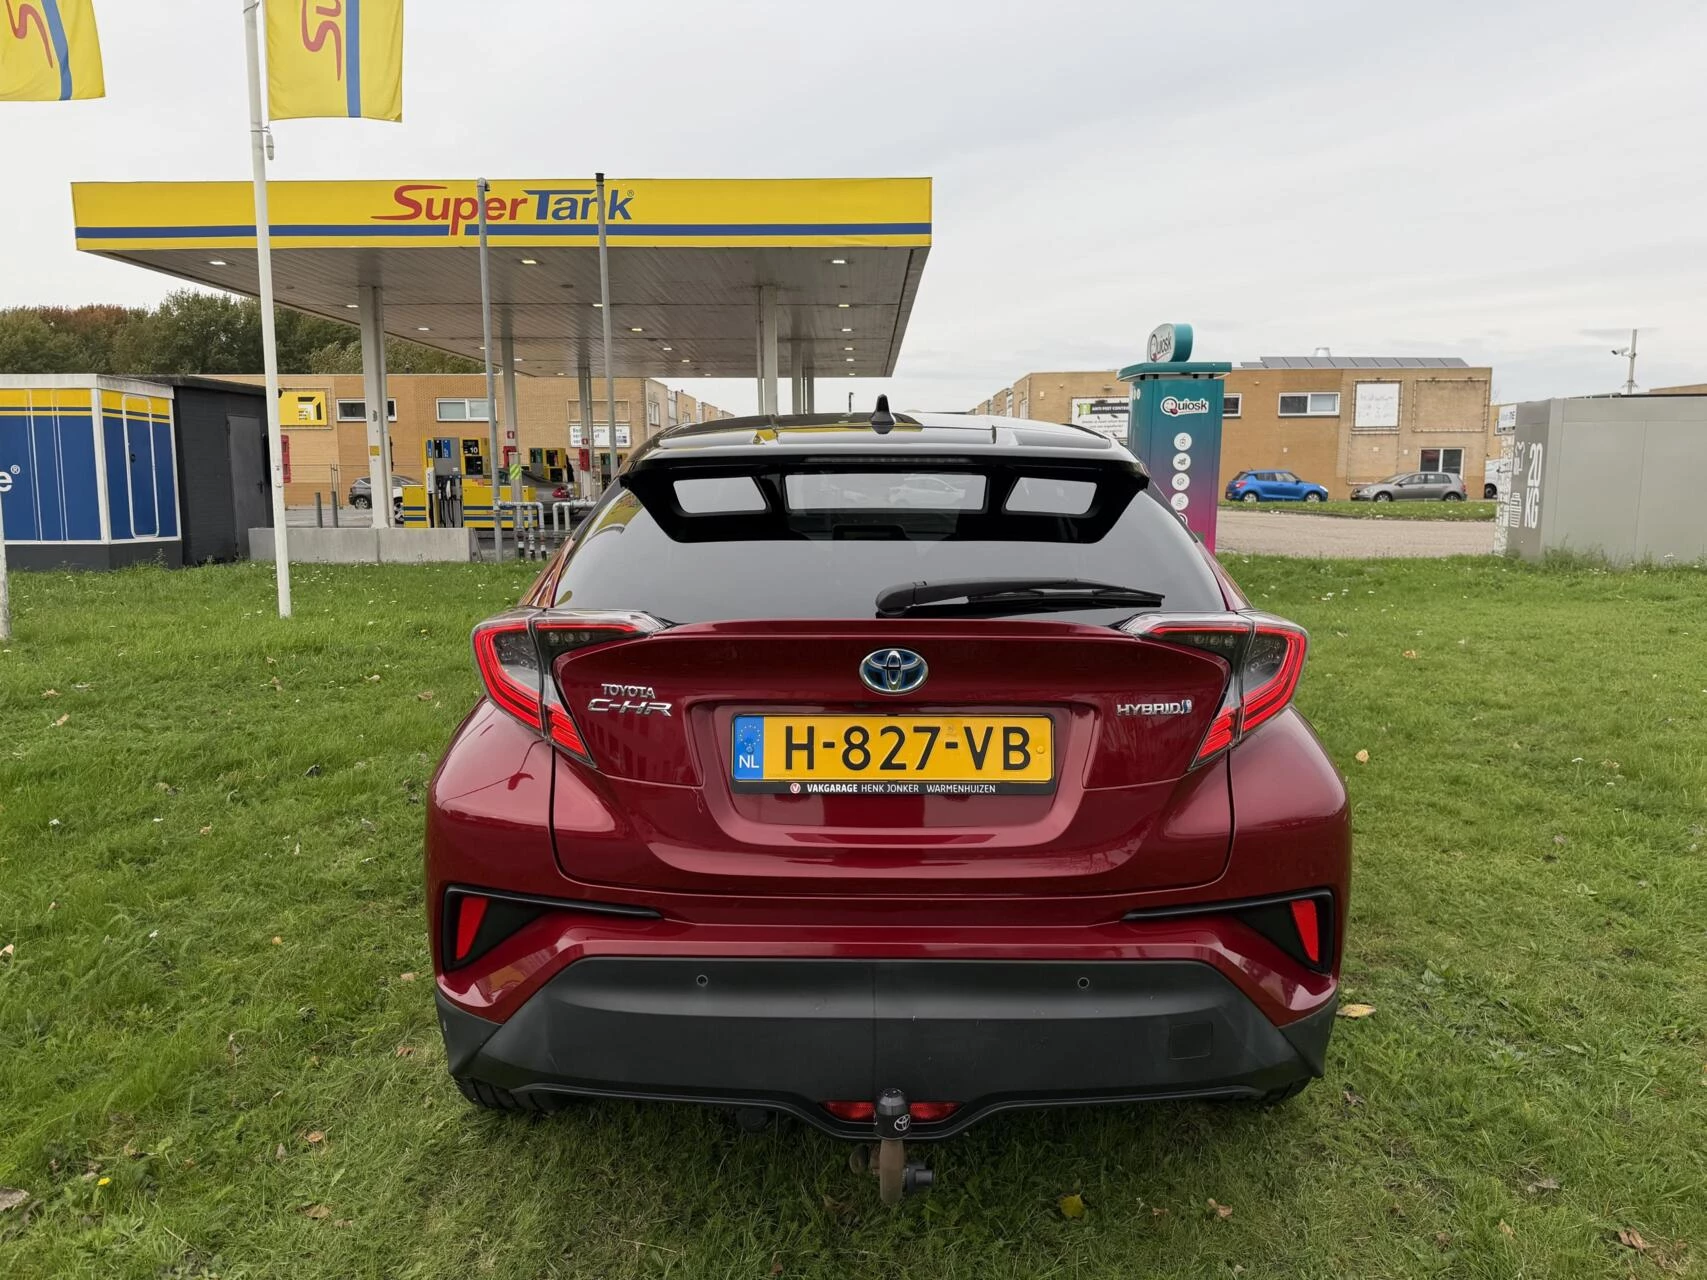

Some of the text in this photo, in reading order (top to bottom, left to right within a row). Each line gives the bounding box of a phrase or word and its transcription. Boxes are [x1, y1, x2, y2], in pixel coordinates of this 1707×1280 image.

[1150, 333, 1172, 361] Quiosk
[1162, 397, 1208, 415] Quiosk
[1527, 442, 1543, 487] 20
[1524, 487, 1540, 529] KG
[601, 683, 656, 699] TOYOTA
[587, 698, 673, 717] C-HR
[1116, 702, 1182, 716] HYBRID
[785, 725, 1032, 771] H-827-VB
[739, 755, 760, 769] NL
[806, 783, 996, 794] VAKGARAGE HENK JONKER WARMENHUIZEN
